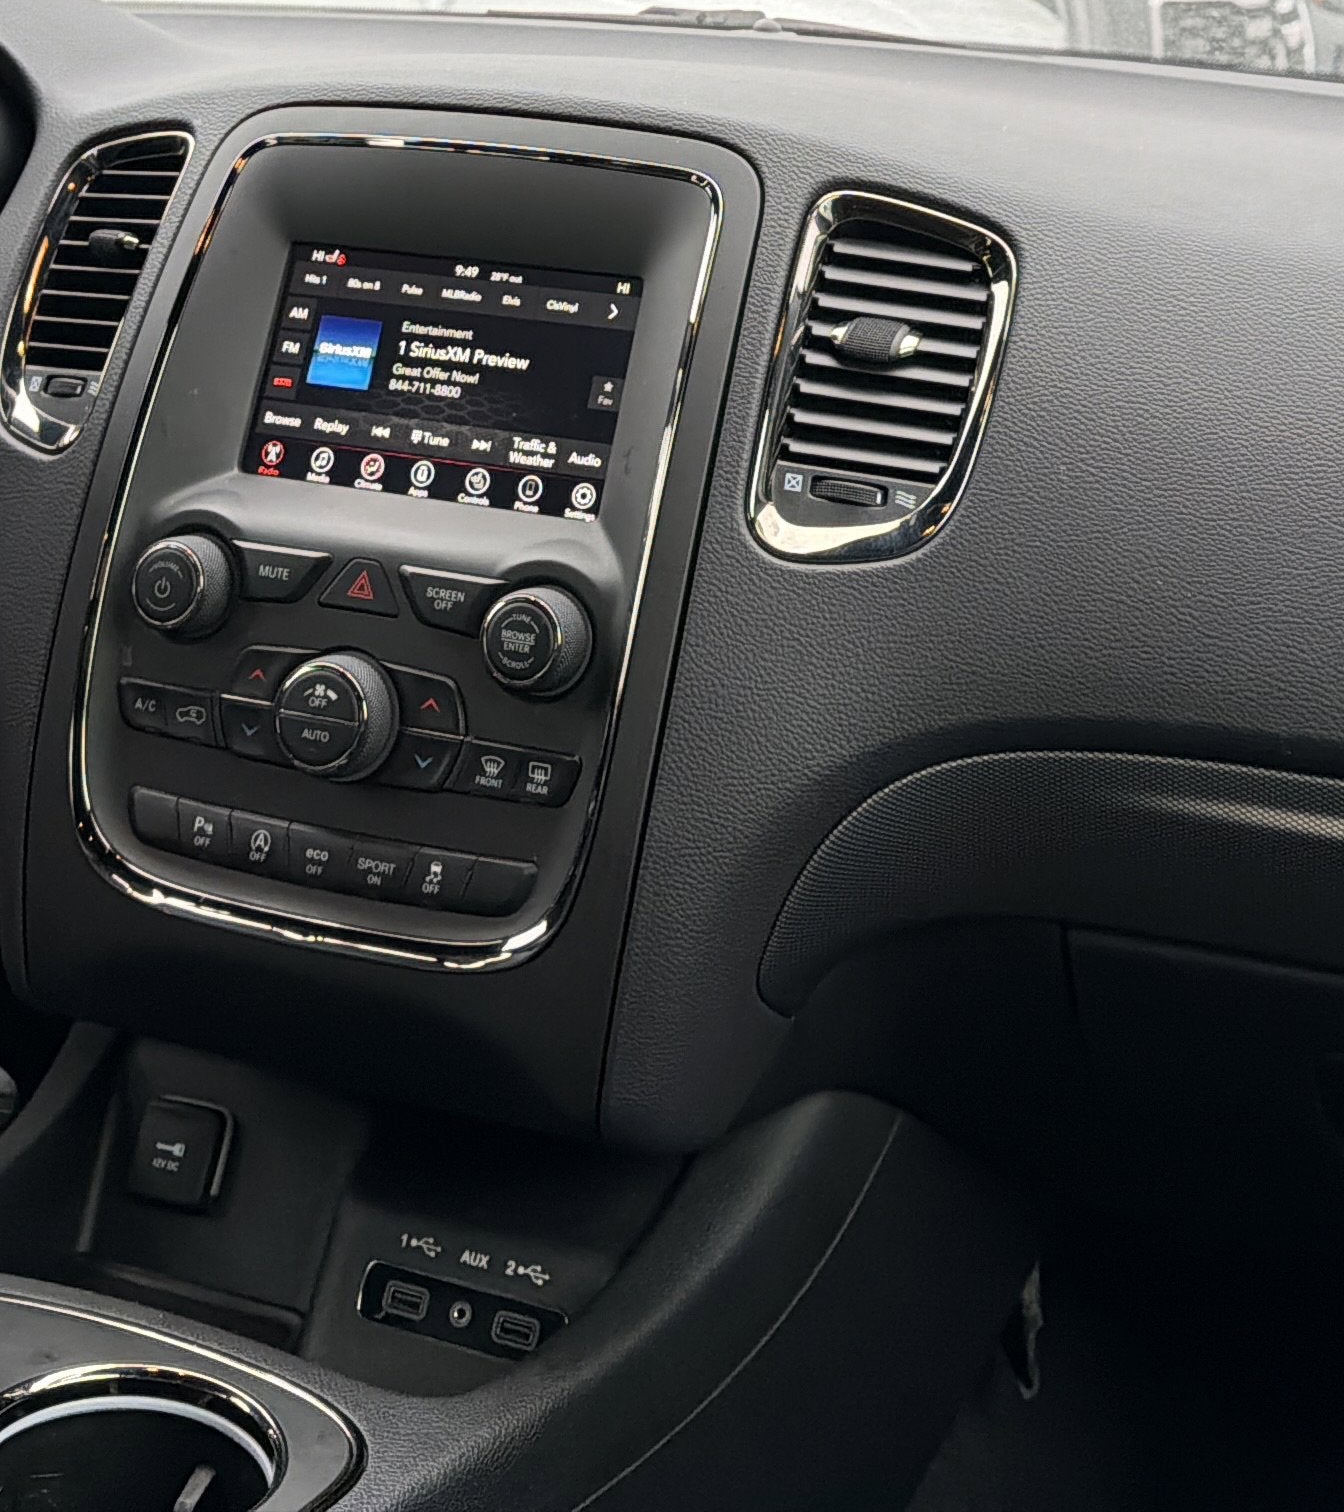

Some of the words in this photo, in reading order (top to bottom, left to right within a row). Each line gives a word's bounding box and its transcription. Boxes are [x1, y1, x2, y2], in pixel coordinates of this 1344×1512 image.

[454, 264, 479, 279] 9:49
[401, 284, 424, 296] Pulse
[616, 281, 631, 294] HI
[288, 306, 309, 320] AM
[401, 320, 474, 341] Entertainment
[281, 340, 301, 354] FM
[318, 341, 373, 359] SiriusXM
[398, 340, 406, 355] 1
[409, 341, 470, 364] SiriusXM
[472, 348, 530, 371] Preview
[392, 362, 422, 377] Great
[422, 366, 450, 381] Offer
[450, 370, 480, 385] Now!
[388, 377, 462, 399] 844-711-8800
[263, 410, 302, 428] Browse
[313, 417, 350, 436] Replay
[422, 432, 450, 448] Tune
[512, 436, 546, 452] Traffic
[546, 441, 557, 454] &
[508, 450, 555, 468] Weather
[567, 451, 602, 468] Audio
[407, 486, 429, 498] Apps
[258, 564, 290, 581] MUTE
[426, 586, 465, 603] SCREEN
[434, 600, 454, 612] OFF
[512, 613, 532, 625] TUNE
[501, 628, 536, 643] BROWSE
[503, 642, 530, 654] ENTER
[501, 656, 529, 670] SCROLL
[134, 697, 157, 712] A/C
[308, 696, 328, 709] OFF
[301, 727, 330, 742] AUTO
[474, 775, 503, 789] FRONT
[525, 782, 549, 796] REAR
[193, 835, 211, 848] OFF
[249, 851, 267, 863] OFF
[305, 848, 329, 862] eco
[305, 864, 324, 876] OFF
[357, 857, 397, 876] SPORT
[366, 875, 382, 887] ON
[421, 882, 441, 895] OFF
[400, 1233, 409, 1248] 1
[459, 1249, 491, 1270] AUX
[504, 1260, 516, 1276] 2
